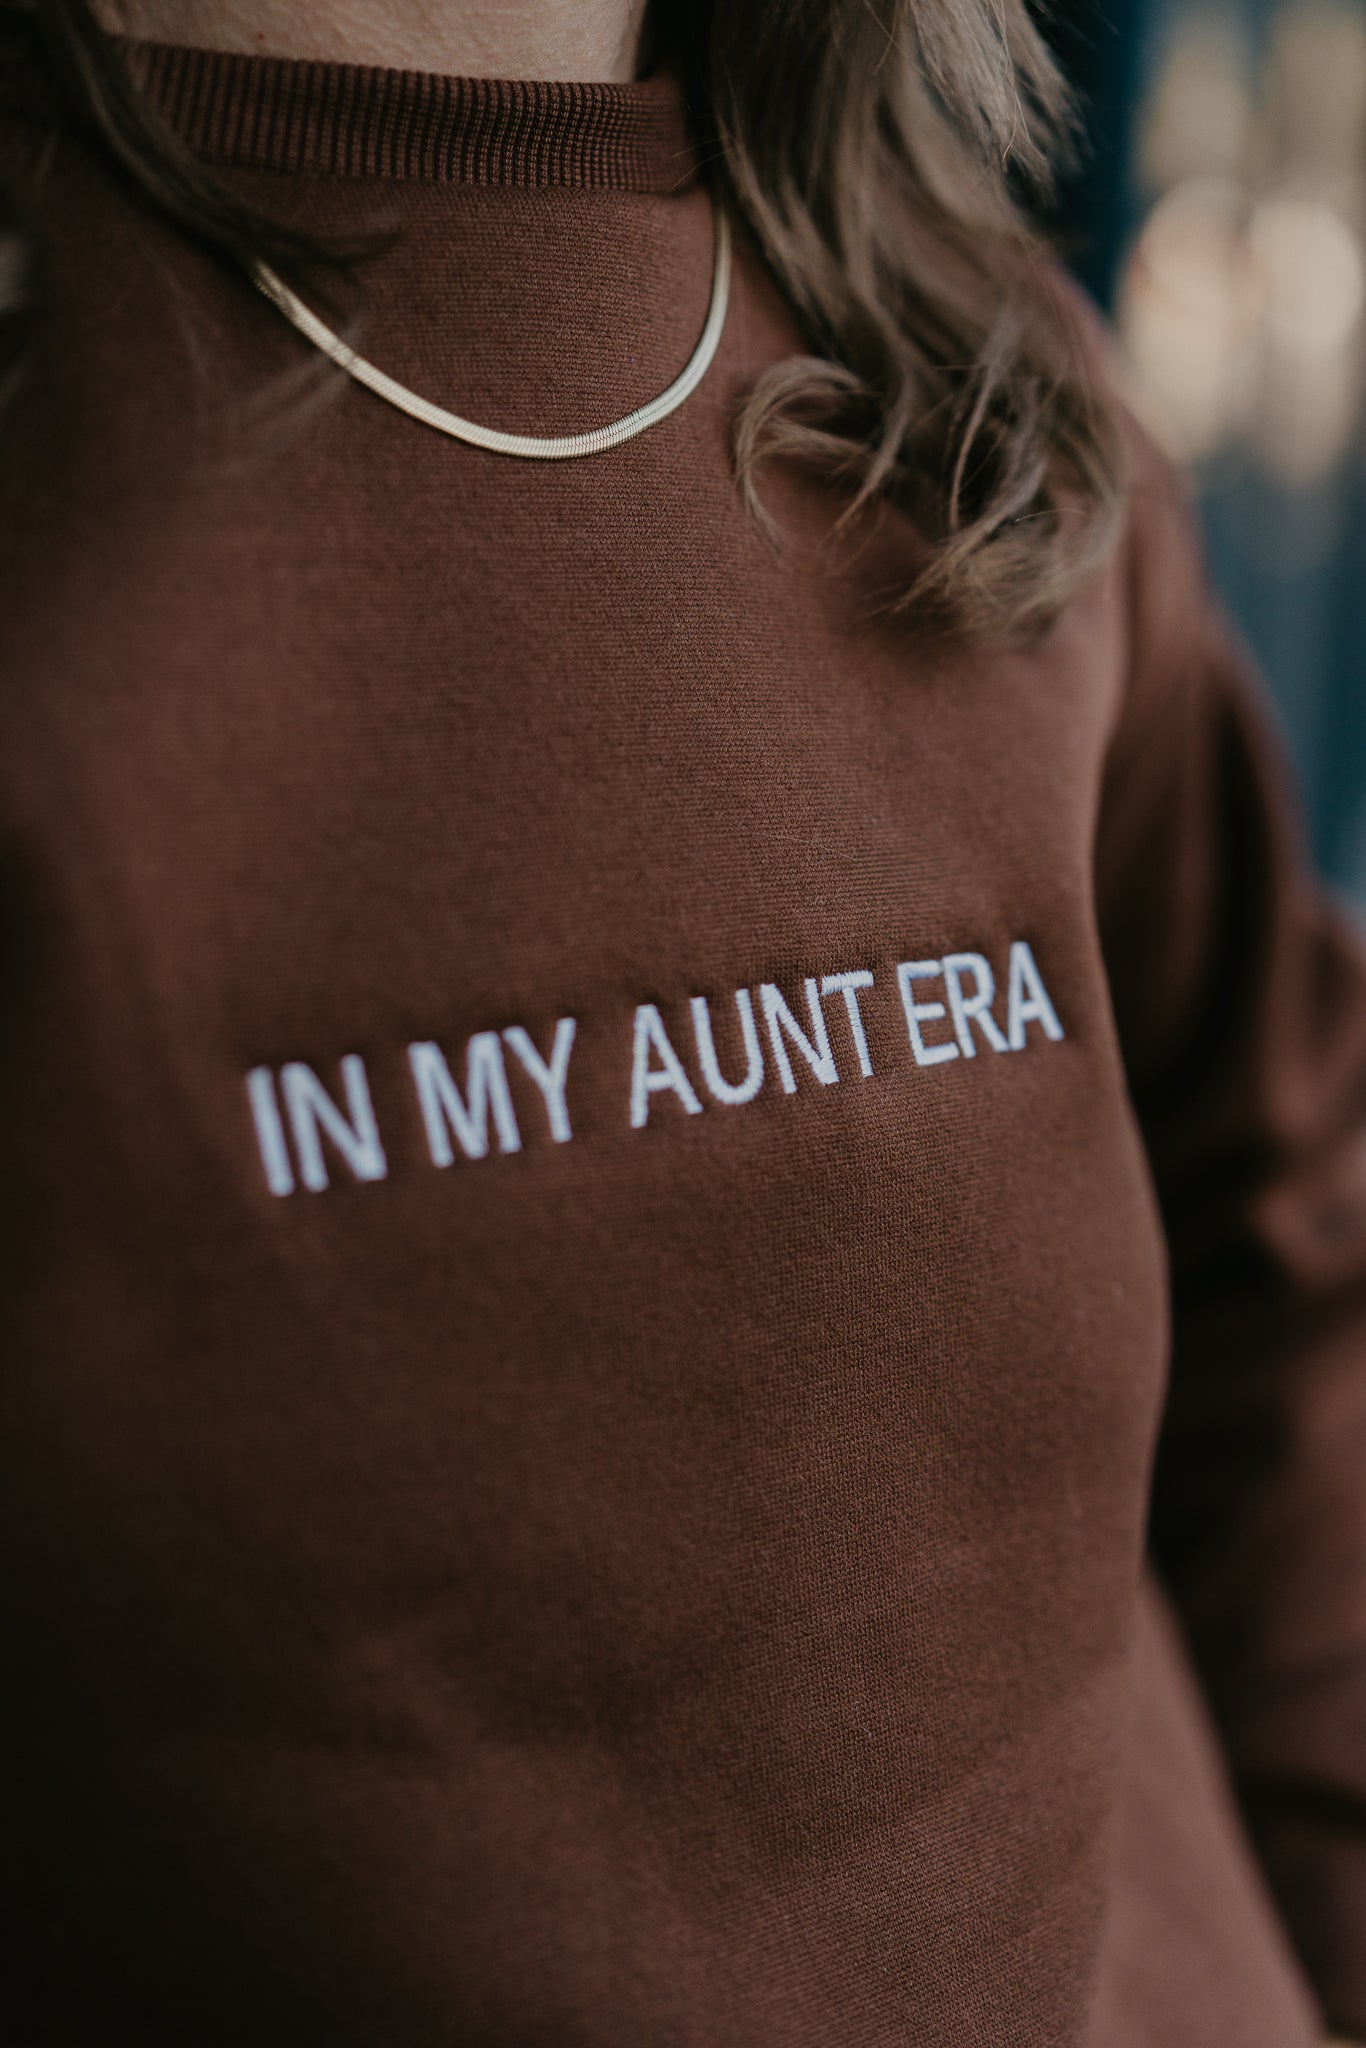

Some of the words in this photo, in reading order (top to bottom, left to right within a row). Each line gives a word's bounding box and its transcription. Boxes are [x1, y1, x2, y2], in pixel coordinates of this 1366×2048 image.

[246, 1054, 388, 1197] IN
[408, 1017, 577, 1168] MY
[629, 969, 874, 1129] AUNT
[896, 941, 1065, 1067] ERA
